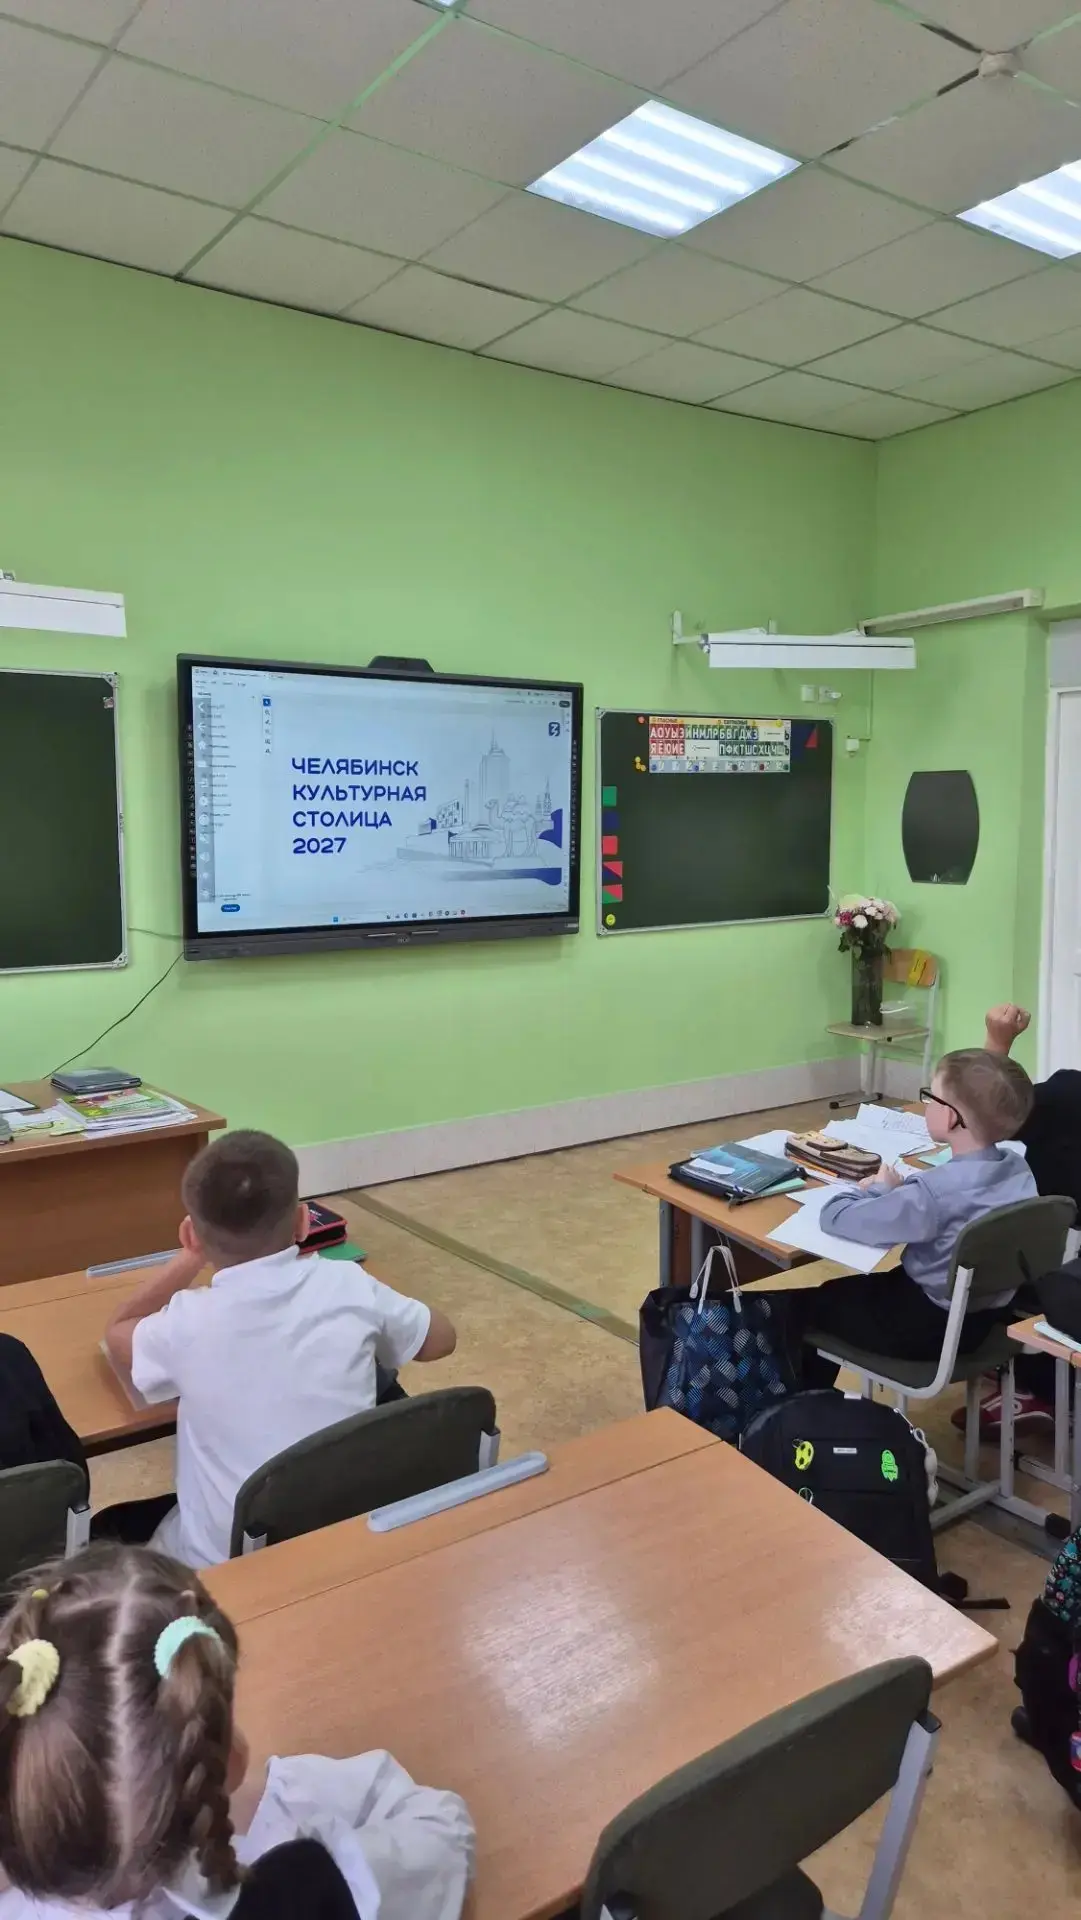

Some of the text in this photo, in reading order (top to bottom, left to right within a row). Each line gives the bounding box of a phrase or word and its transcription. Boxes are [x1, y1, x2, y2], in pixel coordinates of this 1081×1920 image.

[292, 757, 418, 776] ЧЕЛЯБИНСК
[292, 784, 427, 801] КУЛЬТУРНАЯ
[292, 811, 392, 829] СТОЛИЦА
[293, 837, 347, 854] 2027
